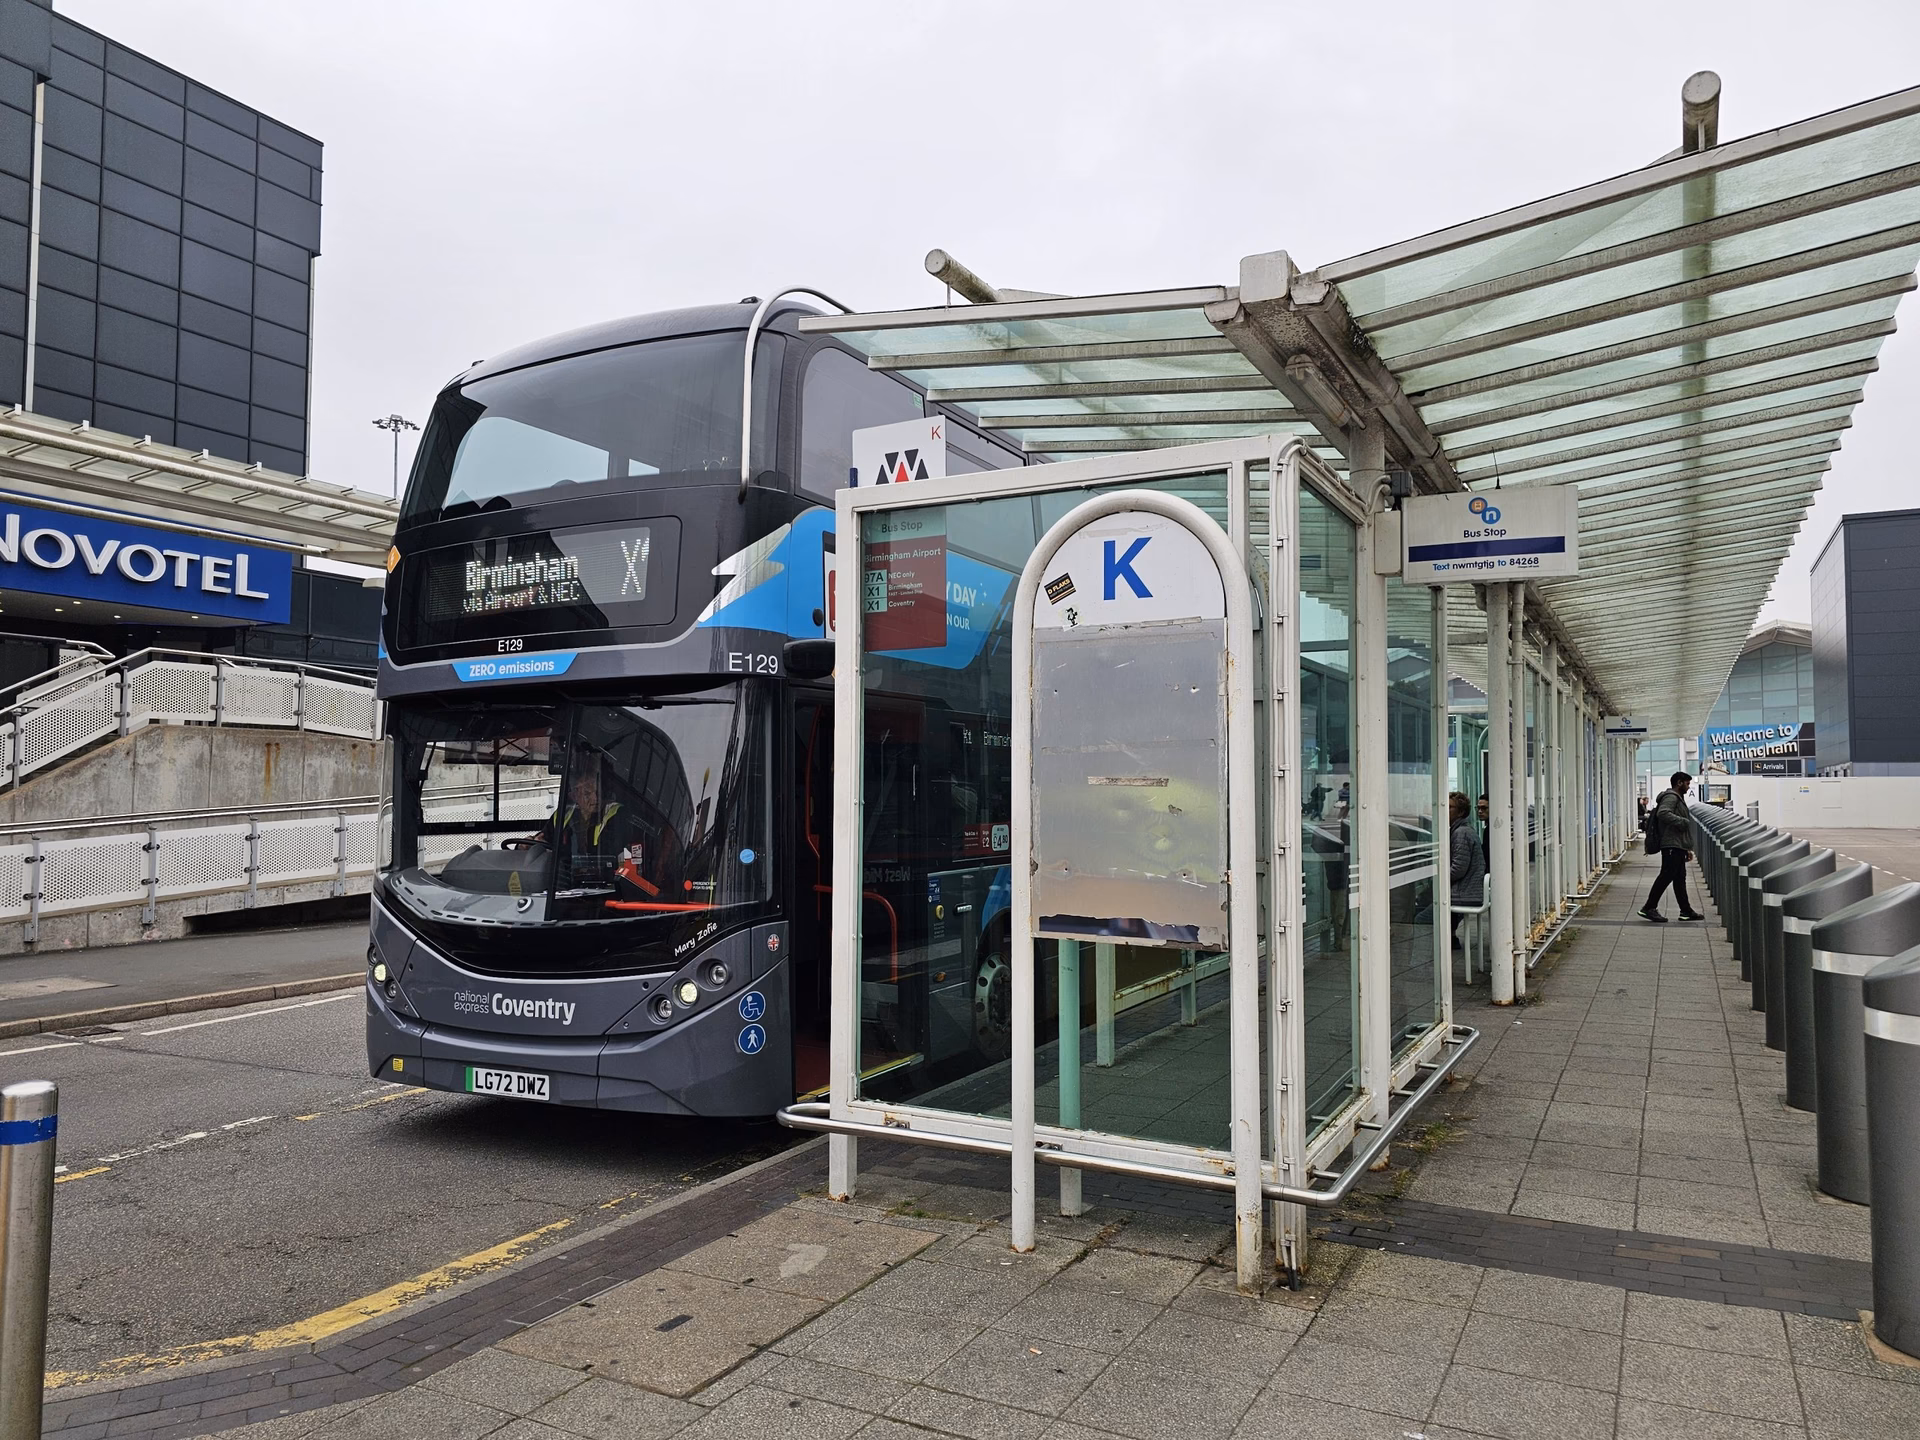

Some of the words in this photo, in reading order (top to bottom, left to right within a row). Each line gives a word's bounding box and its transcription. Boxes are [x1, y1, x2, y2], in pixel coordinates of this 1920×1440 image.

[931, 425, 941, 440] K
[881, 523, 898, 533] Bus
[901, 521, 923, 532] Stop
[1463, 530, 1481, 538] Bus
[1484, 528, 1507, 538] Stop
[864, 551, 911, 563] Birmingham
[912, 547, 941, 558] Airport
[466, 552, 578, 591] Birmingham
[1103, 537, 1153, 600] K
[1433, 562, 1450, 571] Text
[1452, 560, 1495, 569] nwmtgtjg
[1509, 557, 1539, 565] 84268
[888, 571, 902, 579] NEC
[902, 571, 915, 579] only
[461, 592, 483, 612] via
[485, 585, 535, 610] Airport
[538, 584, 549, 604] &
[551, 580, 579, 603] NEC
[867, 586, 880, 597] X1
[888, 582, 923, 591] Birmingham
[953, 583, 977, 608] DAY
[867, 600, 880, 611] X1
[888, 600, 915, 608] Coventry
[953, 616, 970, 631] OUR
[498, 639, 523, 652] E129
[469, 663, 496, 677] ZERO
[498, 660, 555, 675] emissions
[728, 651, 779, 675] E129
[1711, 725, 1775, 746] Welcome
[1778, 723, 1793, 737] to
[1713, 741, 1798, 762] Birmingham
[1762, 762, 1785, 770] Arrivals
[1688, 789, 1696, 798] A
[674, 938, 695, 957] Mary
[696, 922, 718, 941] Zofie
[453, 1001, 489, 1014] express
[454, 990, 490, 1004] national
[492, 993, 576, 1026] Coventry
[475, 1070, 513, 1092] LG72
[517, 1075, 546, 1096] DWZ
